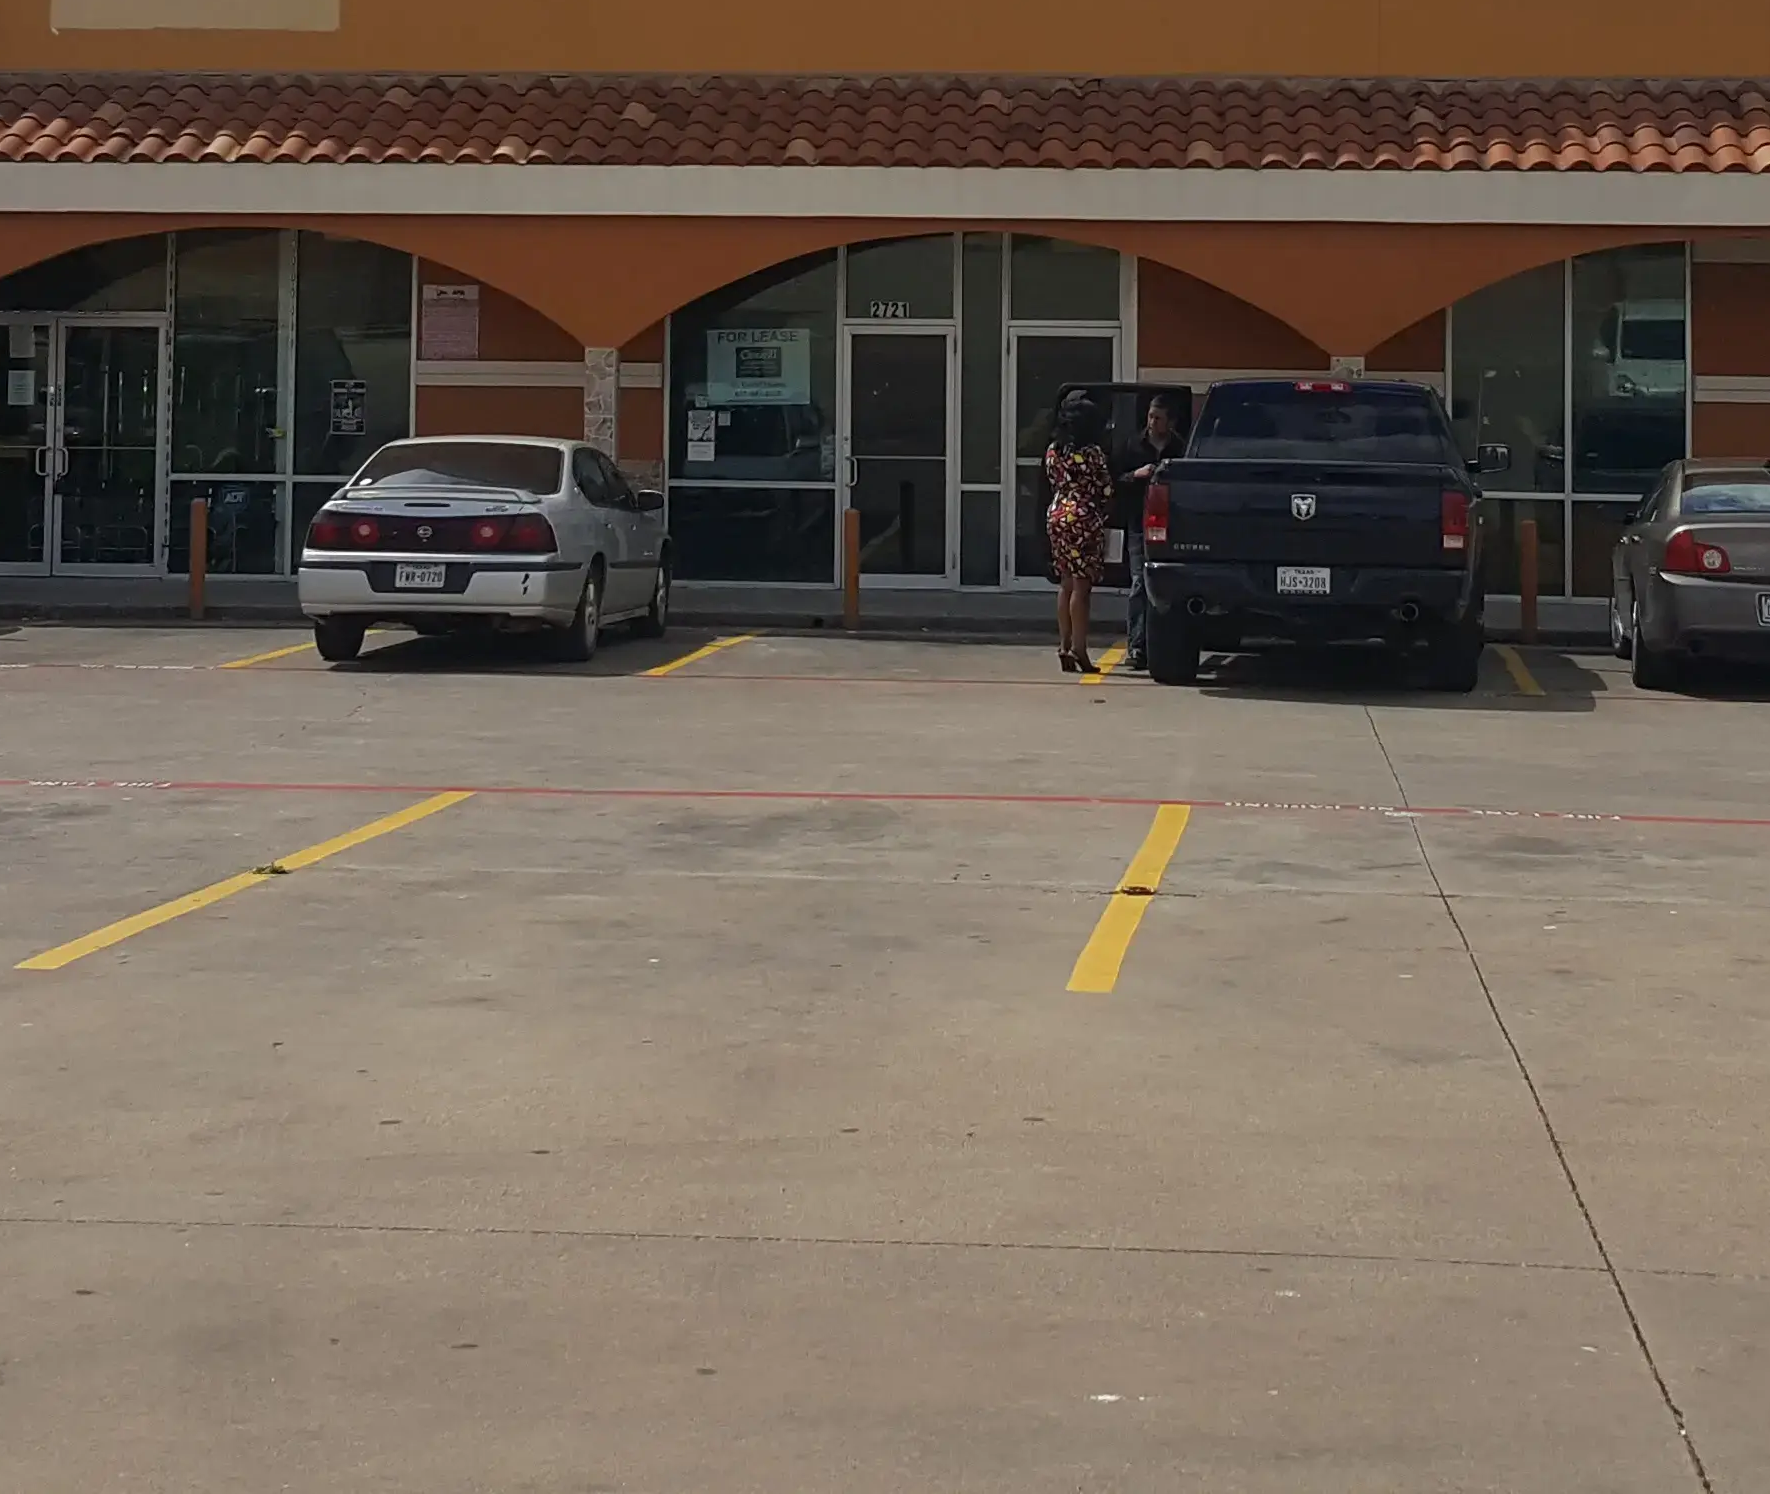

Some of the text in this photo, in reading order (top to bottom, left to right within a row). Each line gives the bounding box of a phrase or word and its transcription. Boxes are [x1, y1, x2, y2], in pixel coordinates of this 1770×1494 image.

[871, 302, 909, 318] 2721
[717, 330, 799, 344] FOR LEASE
